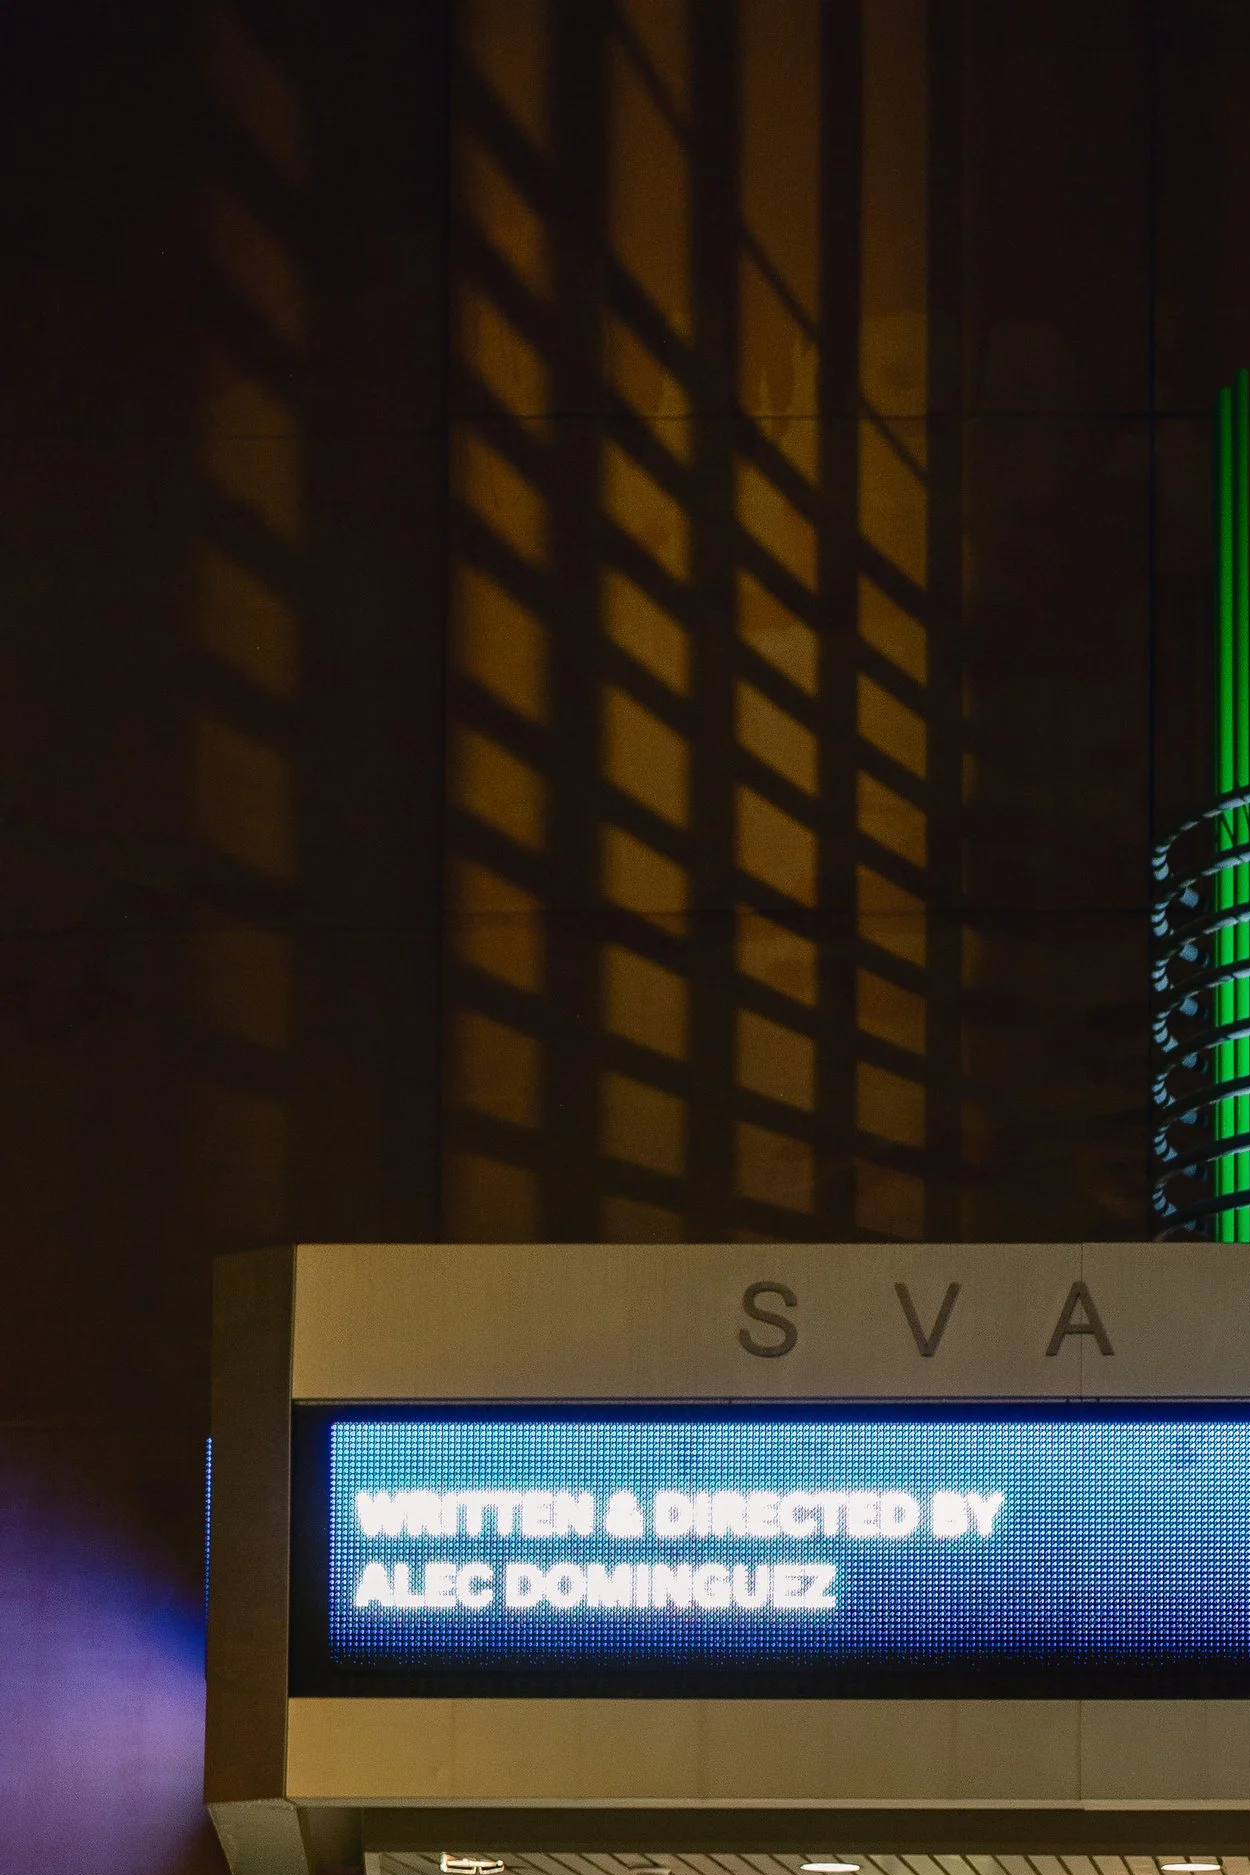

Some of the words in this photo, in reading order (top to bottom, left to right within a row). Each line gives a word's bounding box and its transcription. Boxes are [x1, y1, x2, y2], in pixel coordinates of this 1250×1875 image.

[738, 1281, 1115, 1358] SVA
[356, 1491, 595, 1537] WRITTEN
[605, 1491, 644, 1537] &
[655, 1491, 920, 1537] DIRECTED
[932, 1491, 1004, 1537] BY
[354, 1562, 494, 1608] ALEC
[505, 1562, 838, 1608] DOMINGUEZ
